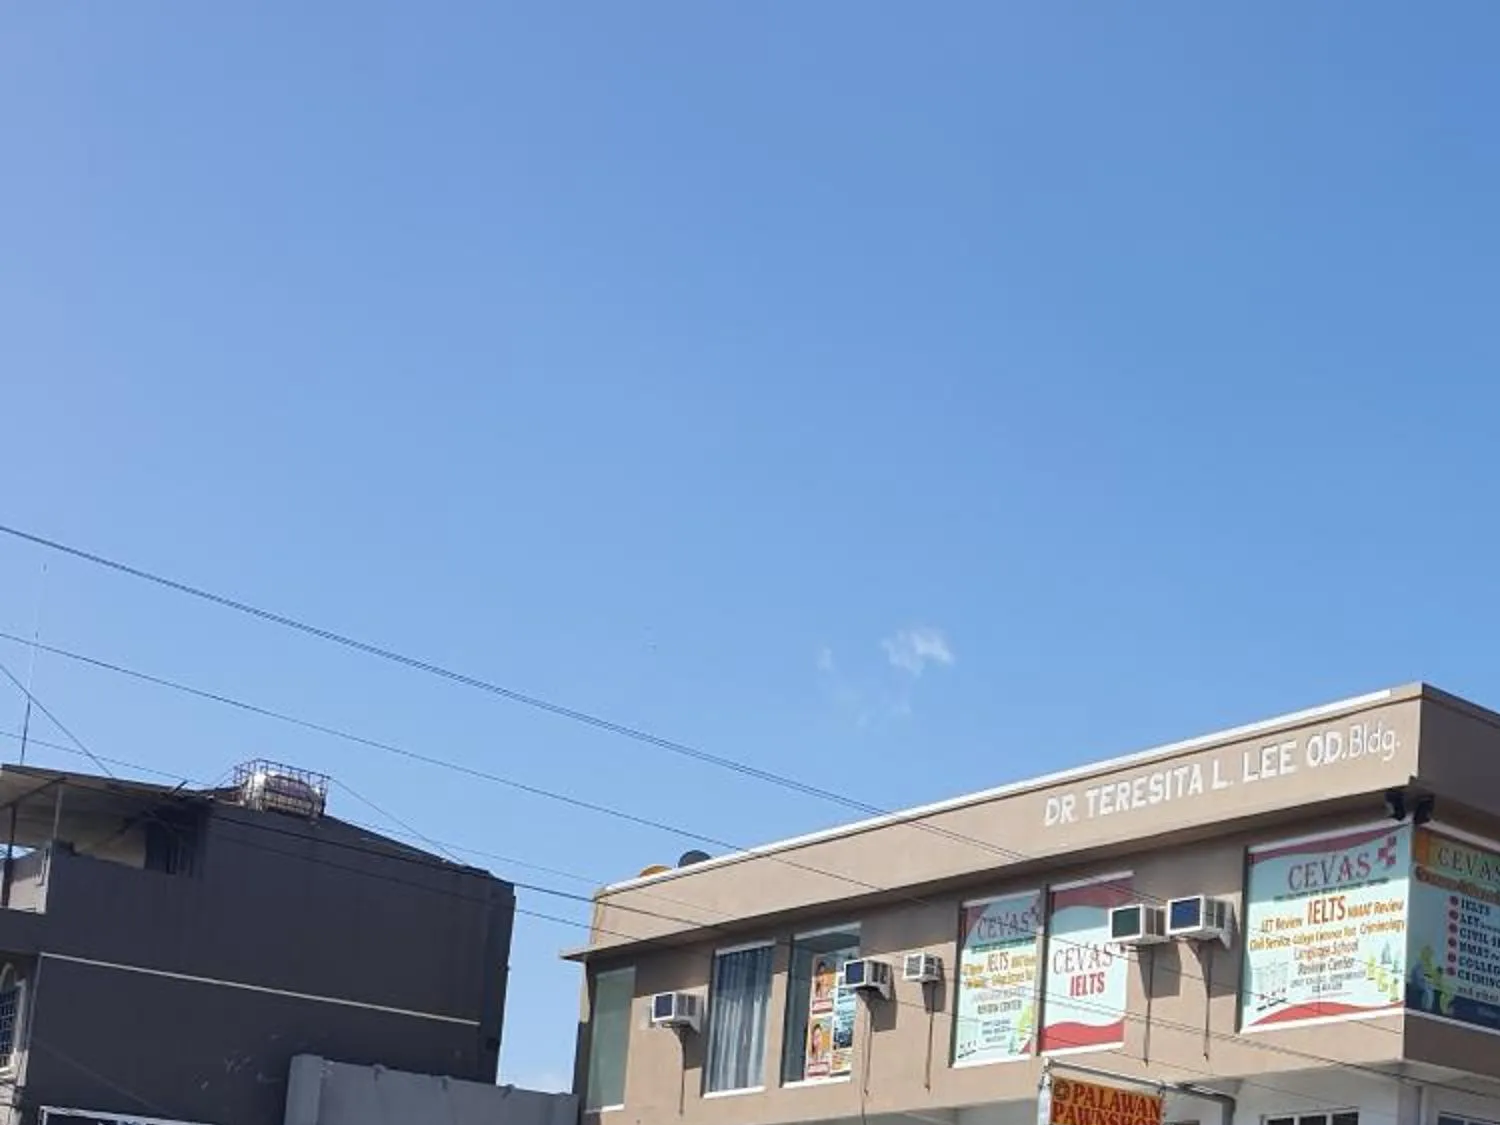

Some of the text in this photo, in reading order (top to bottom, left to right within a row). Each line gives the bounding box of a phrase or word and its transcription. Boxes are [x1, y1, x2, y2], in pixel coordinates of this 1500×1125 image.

[1085, 766, 1204, 819] TERESITA
[1243, 741, 1299, 782] LEE
[1288, 852, 1372, 891] CEVAS
[1308, 896, 1346, 925] IELTS
[1374, 899, 1403, 914] Review
[1461, 900, 1490, 916] IELTS
[976, 910, 1030, 941] CEVAS
[1460, 927, 1489, 944] CIVIL
[986, 951, 1010, 972] IELTS
[1053, 944, 1114, 975] CEVAS
[1069, 972, 1105, 997] IELTS
[1073, 1082, 1162, 1121] PALAWAN
